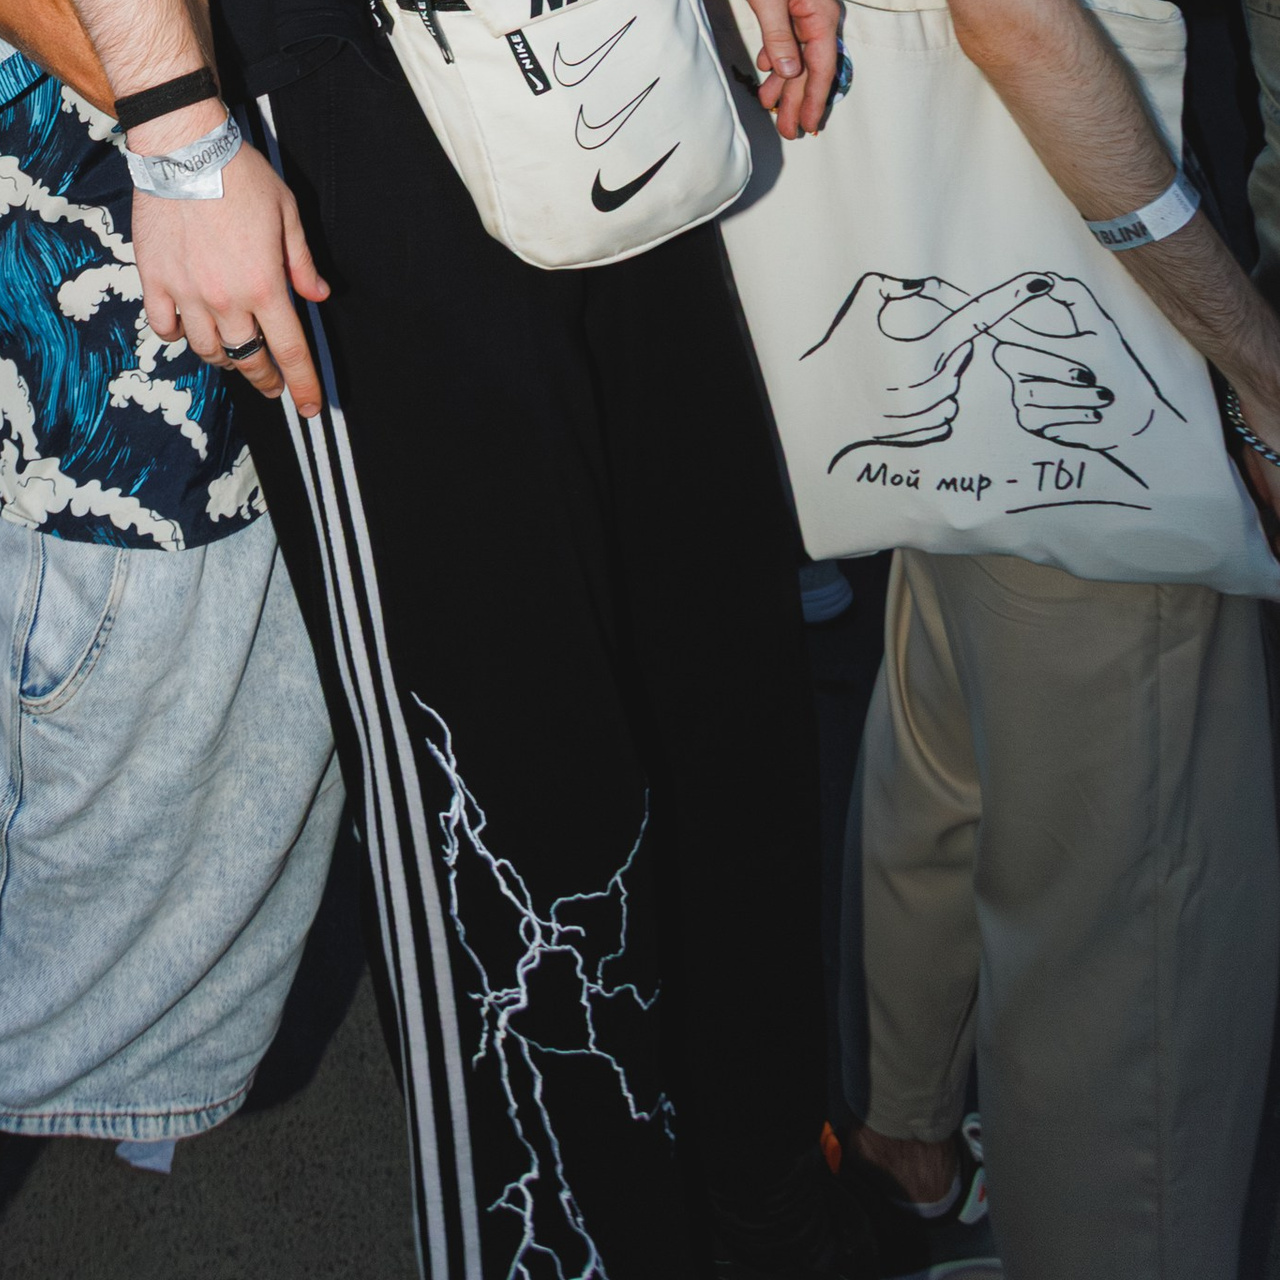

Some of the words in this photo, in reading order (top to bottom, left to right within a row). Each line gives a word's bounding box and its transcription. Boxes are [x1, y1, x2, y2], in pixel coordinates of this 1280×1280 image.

[417, 1, 437, 37] NIKE
[510, 33, 534, 70] NIKE
[856, 462, 920, 491] Мой
[936, 472, 992, 501] мир
[1032, 458, 1086, 491] ТЫ
